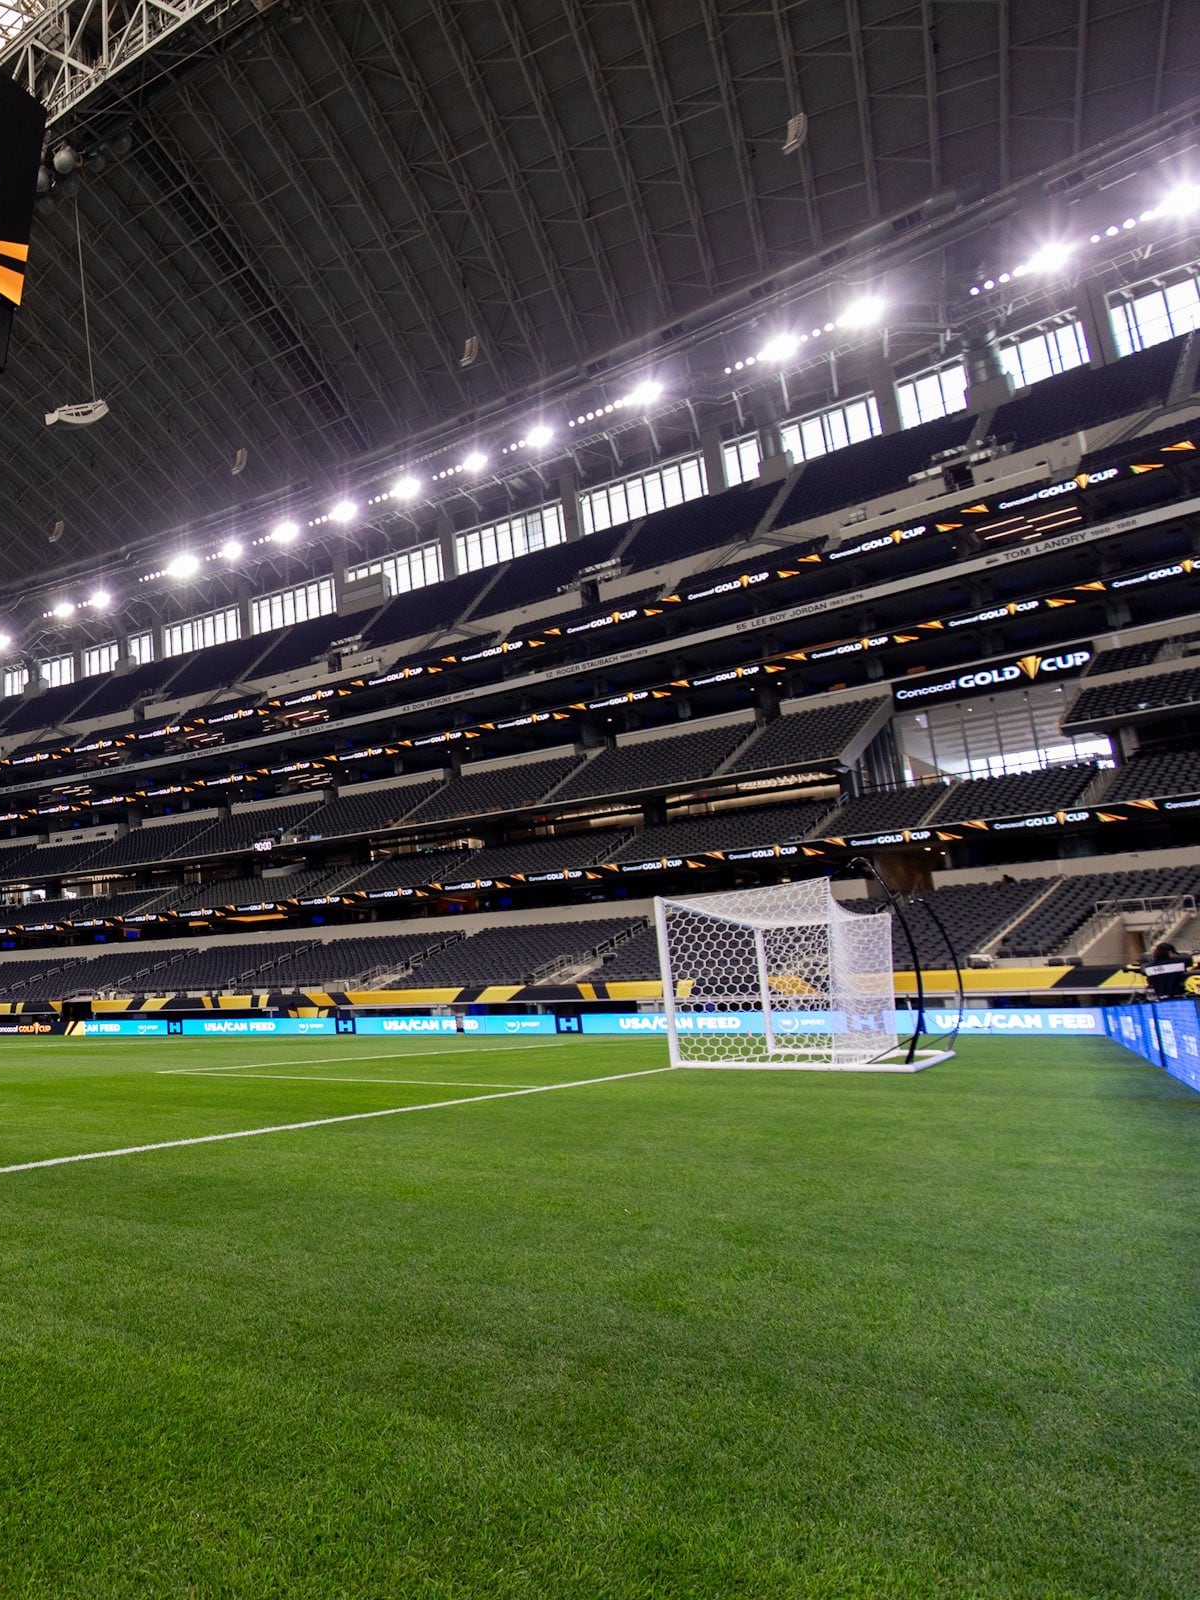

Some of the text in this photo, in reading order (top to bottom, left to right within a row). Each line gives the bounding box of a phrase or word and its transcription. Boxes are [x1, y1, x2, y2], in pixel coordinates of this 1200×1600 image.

[1037, 481, 1078, 499] GOLD
[1088, 468, 1119, 484] CUP
[861, 536, 893, 551] GOLD
[901, 526, 926, 540] CUP
[1003, 547, 1031, 561] TOM
[1036, 532, 1087, 554] LANDRY
[1148, 565, 1183, 580] GOLD
[715, 580, 741, 594] GOLD
[749, 572, 770, 585] CUP
[736, 623, 747, 631] 55
[751, 616, 767, 627] LEE
[769, 613, 787, 624] ROY
[789, 602, 827, 617] JORDAN
[979, 607, 1008, 621] GOLD
[1016, 600, 1039, 613] CUP
[556, 664, 581, 677] ROGER
[581, 656, 619, 670] STAUBACH
[896, 650, 1090, 700] Concacaf GOLD CUP
[412, 702, 426, 710] DON
[426, 696, 450, 708] PERKINS
[1025, 816, 1057, 828] GOLD
[1066, 812, 1089, 823] CUP
[877, 835, 904, 845] GOLD
[99, 1023, 121, 1033] FEED
[204, 1021, 276, 1033] USA/CAN FEED
[383, 1018, 439, 1032] USA/CAN
[697, 1016, 742, 1030] FEED
[801, 1018, 825, 1027] SPORT
[935, 1011, 1095, 1031] USA/CAN FEED
[18, 1025, 34, 1034] GOLD
[38, 1025, 51, 1033] CUP
